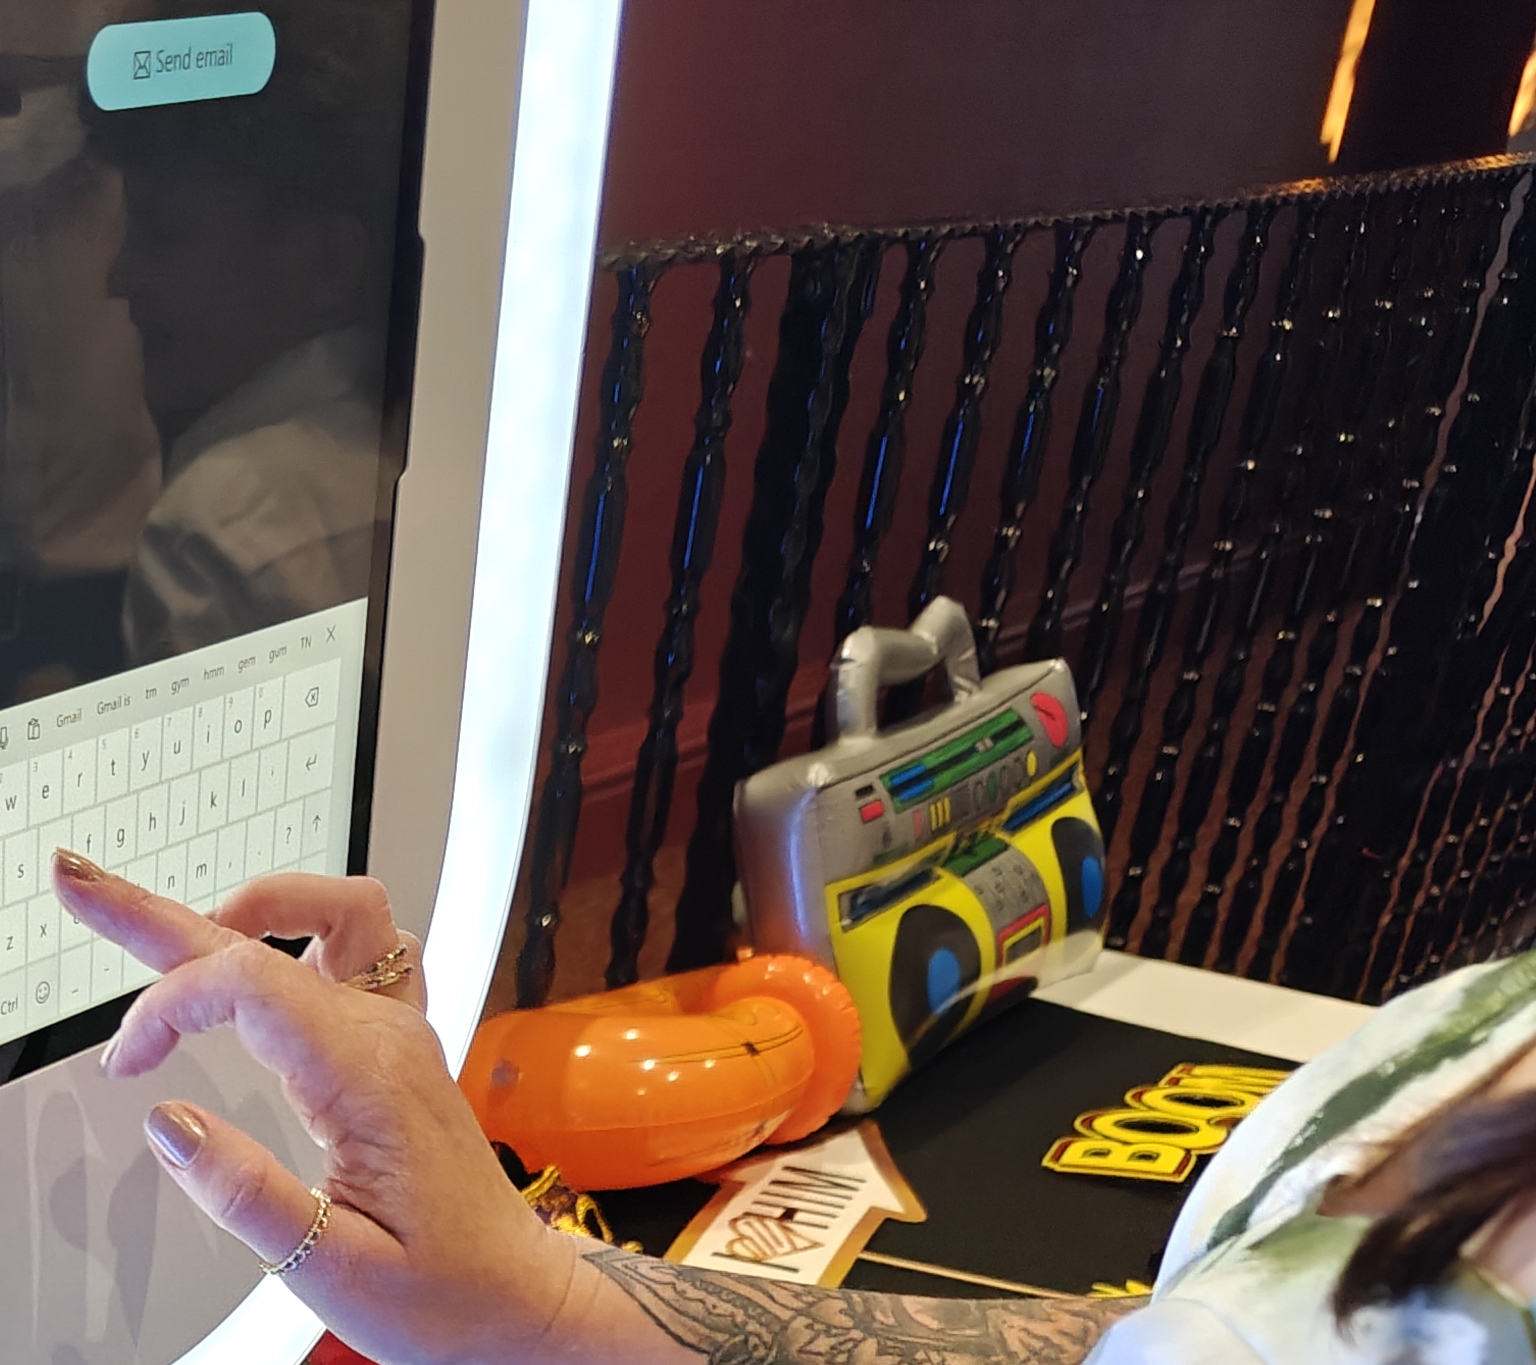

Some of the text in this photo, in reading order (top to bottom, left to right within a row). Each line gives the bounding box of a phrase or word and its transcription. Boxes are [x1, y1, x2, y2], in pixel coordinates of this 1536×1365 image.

[156, 43, 232, 72] Send email
[56, 636, 312, 728] Gmail Gmail is tm gym hmm gem gum TN
[5, 795, 18, 812] w
[41, 784, 50, 800] e
[77, 772, 83, 788] r
[110, 759, 116, 776] t
[141, 750, 150, 772] y
[173, 740, 182, 755] u
[206, 724, 211, 744] i
[234, 719, 243, 734] o
[263, 709, 272, 730] p
[17, 863, 25, 879] s
[86, 833, 92, 854] f
[116, 828, 125, 849] g
[148, 812, 157, 832] h
[179, 801, 186, 827] j
[210, 791, 217, 808] k
[241, 778, 246, 798] l
[6, 935, 14, 951] z
[40, 923, 47, 938] x
[167, 875, 176, 890] n
[195, 863, 208, 879] m
[286, 826, 292, 844] ?
[1, 997, 18, 1015] Ctrl
[743, 1166, 866, 1230] HIM
